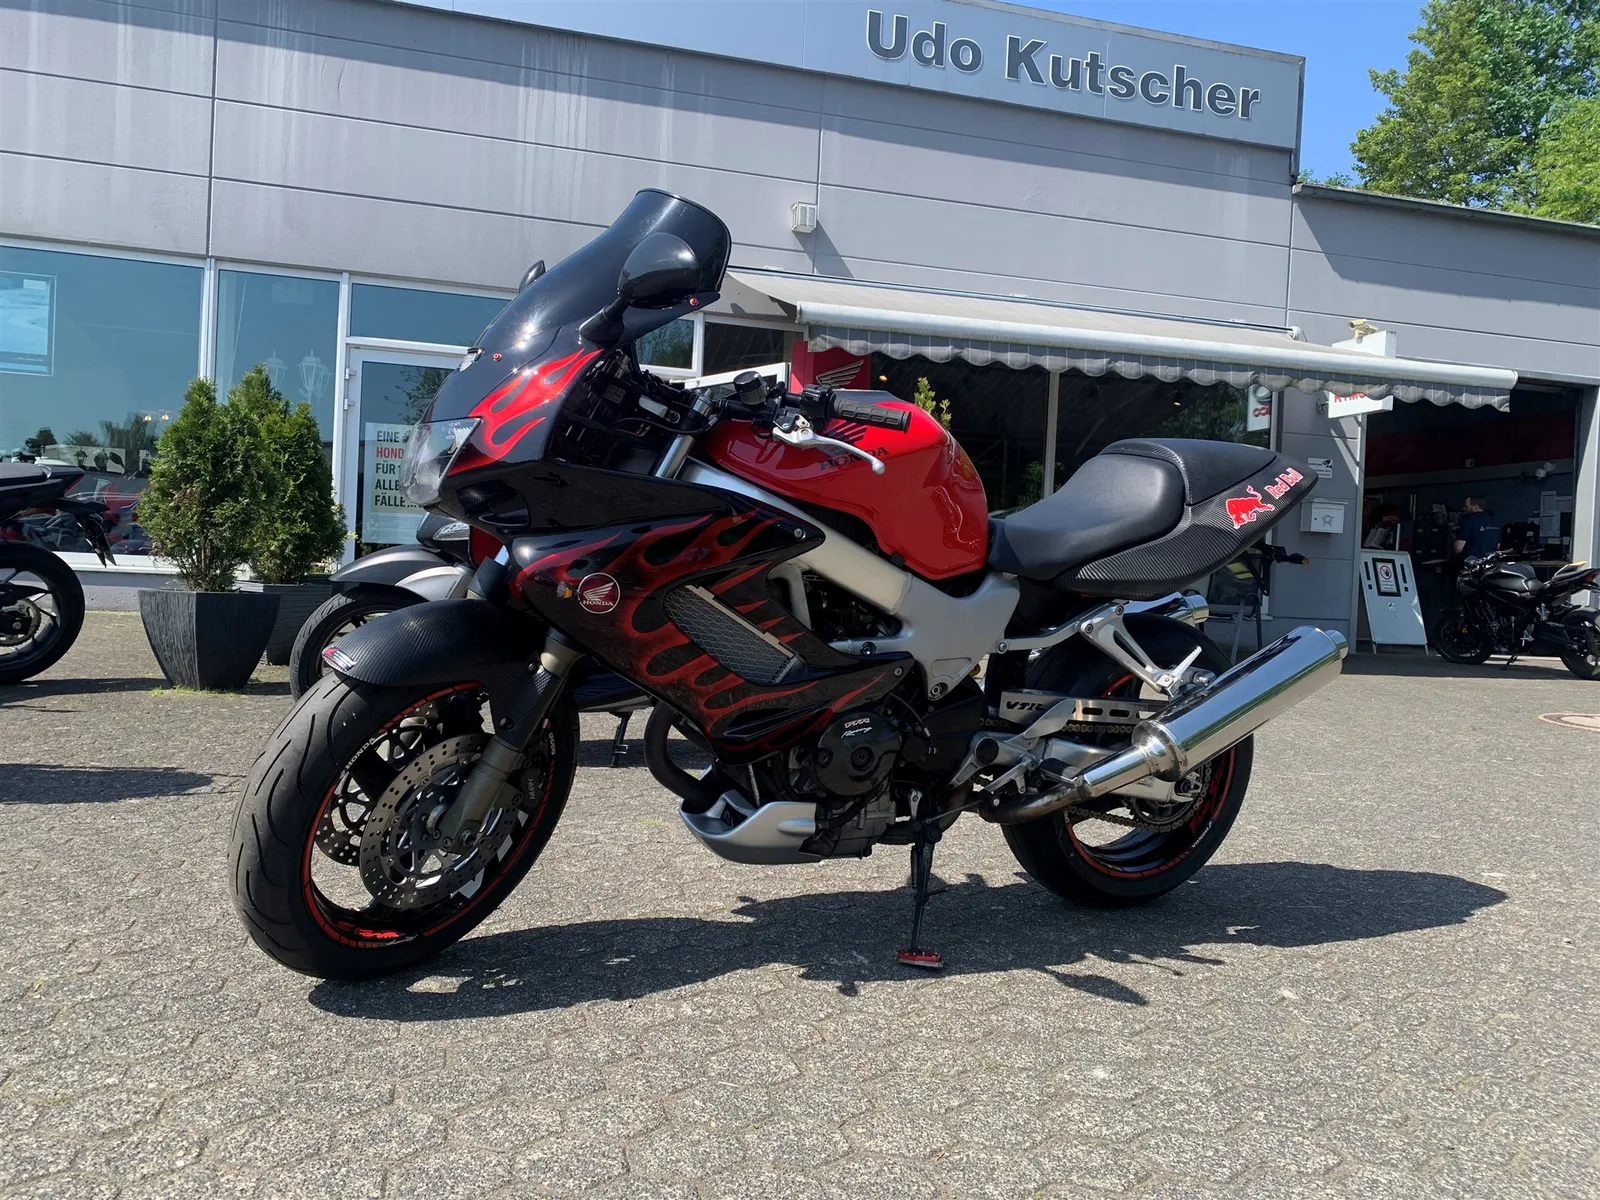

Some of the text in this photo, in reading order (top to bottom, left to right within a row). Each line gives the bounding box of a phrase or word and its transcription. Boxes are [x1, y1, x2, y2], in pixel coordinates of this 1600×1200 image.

[866, 9, 1261, 120] Udo Kutscher
[376, 430, 400, 443] EINE
[376, 447, 405, 459] HOND
[375, 460, 396, 475] FÜR
[374, 479, 399, 491] ALLE
[1264, 467, 1304, 500] Red Bull
[344, 737, 375, 770] HONDA
